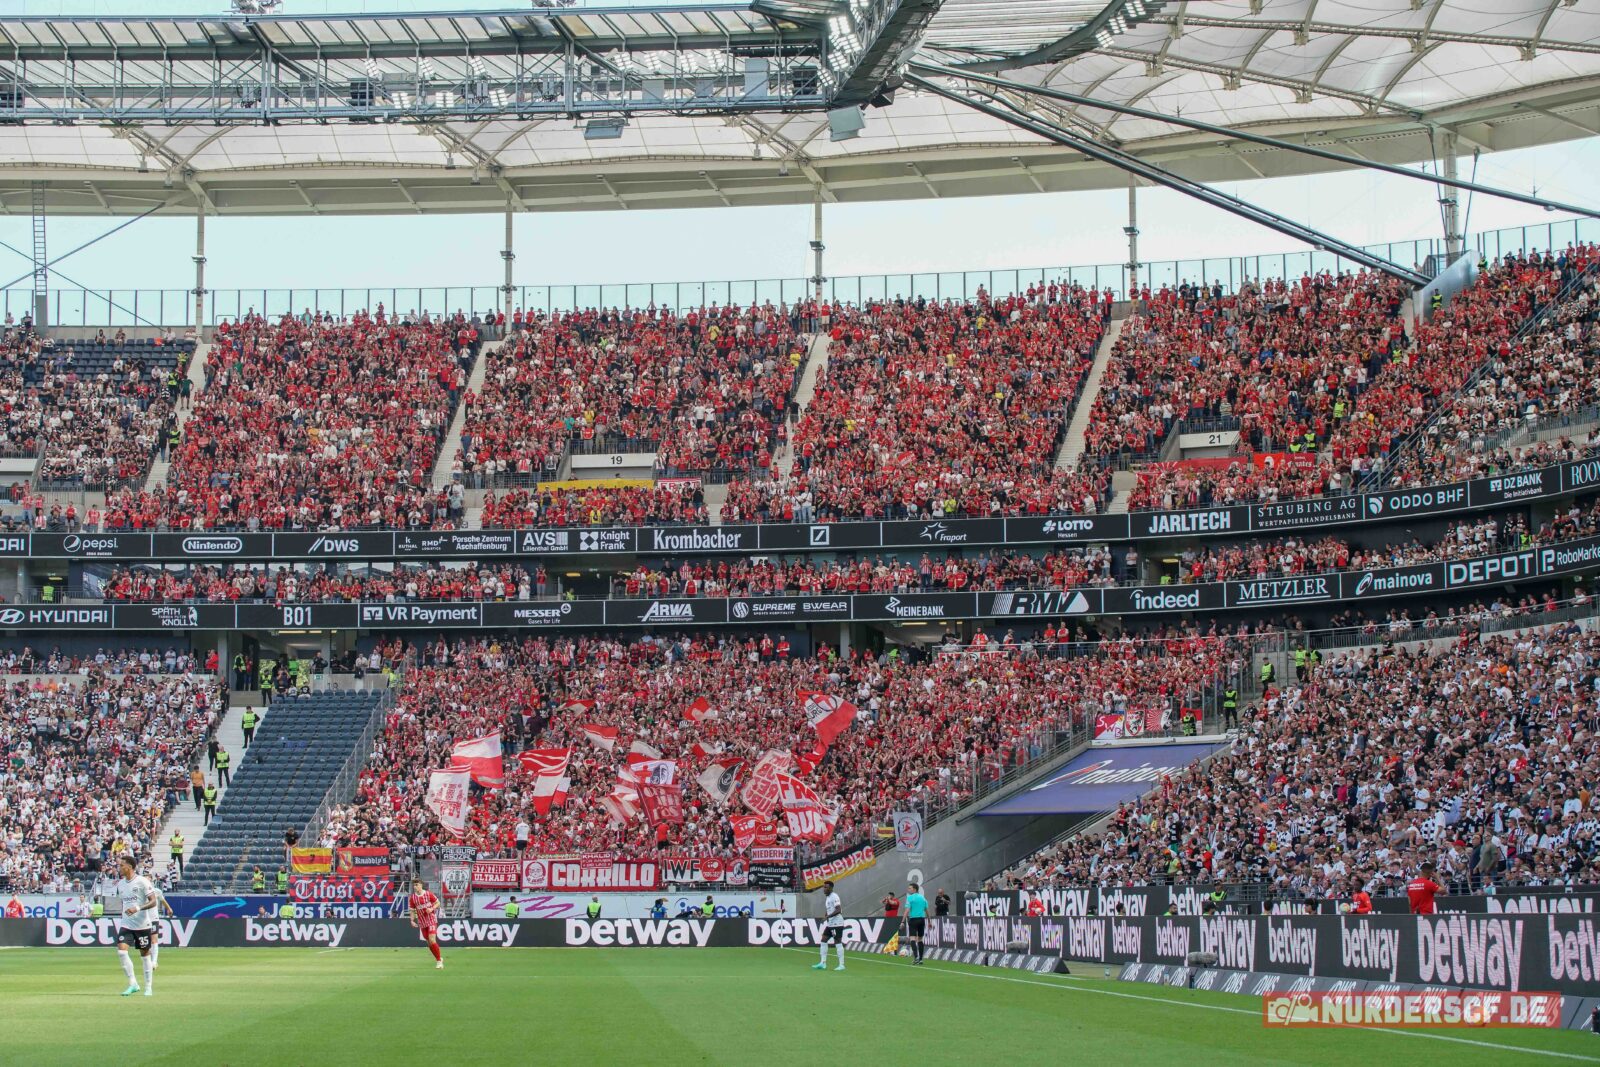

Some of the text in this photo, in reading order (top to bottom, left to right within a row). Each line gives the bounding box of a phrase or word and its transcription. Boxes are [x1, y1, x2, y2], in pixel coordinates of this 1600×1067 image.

[1209, 435, 1221, 444] 21
[610, 456, 623, 465] 19
[1503, 472, 1543, 490] DZ BANK
[1390, 488, 1464, 510] ODDO BHF
[1503, 487, 1543, 499] Die Initiativbank
[1258, 498, 1357, 518] STEUBING AG
[1057, 519, 1094, 531] LOTTO
[1149, 511, 1231, 534] JARLTECH
[1258, 512, 1357, 527] WERTPAPIERHANDELSBANK
[82, 537, 118, 551] pepsi
[451, 535, 512, 543] Porsche Zentrum
[522, 532, 556, 546] AVS
[600, 531, 630, 541] Knight
[653, 528, 742, 550] Krombacher
[940, 532, 967, 543] Fraport
[187, 540, 239, 552] Nintendo
[324, 539, 359, 552] DWS
[456, 542, 507, 551] Aschaffenburg
[600, 541, 625, 550] Frank
[1449, 553, 1534, 585] DEPOT
[1239, 578, 1329, 600] METZLER
[1374, 572, 1433, 591] mainova
[752, 603, 796, 611] SUPREME
[1135, 589, 1199, 609] indeed
[29, 610, 108, 623] HYUNDAI
[151, 607, 180, 616] SPÄTH
[386, 606, 477, 623] VR Payment
[514, 609, 561, 618] MESSER
[473, 864, 518, 873] SYNTHESIA
[801, 845, 875, 886] FREIBURG
[474, 873, 505, 882] ULTRAS
[363, 880, 390, 899] 97
[270, 902, 314, 918] Jbs
[46, 917, 199, 947] betay
[138, 935, 149, 946] 35
[245, 918, 347, 947] betway
[420, 919, 521, 947] etway
[566, 918, 716, 947] betway
[1041, 917, 1064, 958] betway
[1069, 916, 1106, 962] betway
[1112, 917, 1141, 963] betway
[1156, 917, 1190, 967] betway
[1200, 916, 1257, 972] betway
[1268, 916, 1317, 977] betway
[1341, 916, 1399, 983] betway
[1417, 915, 1524, 992] betway
